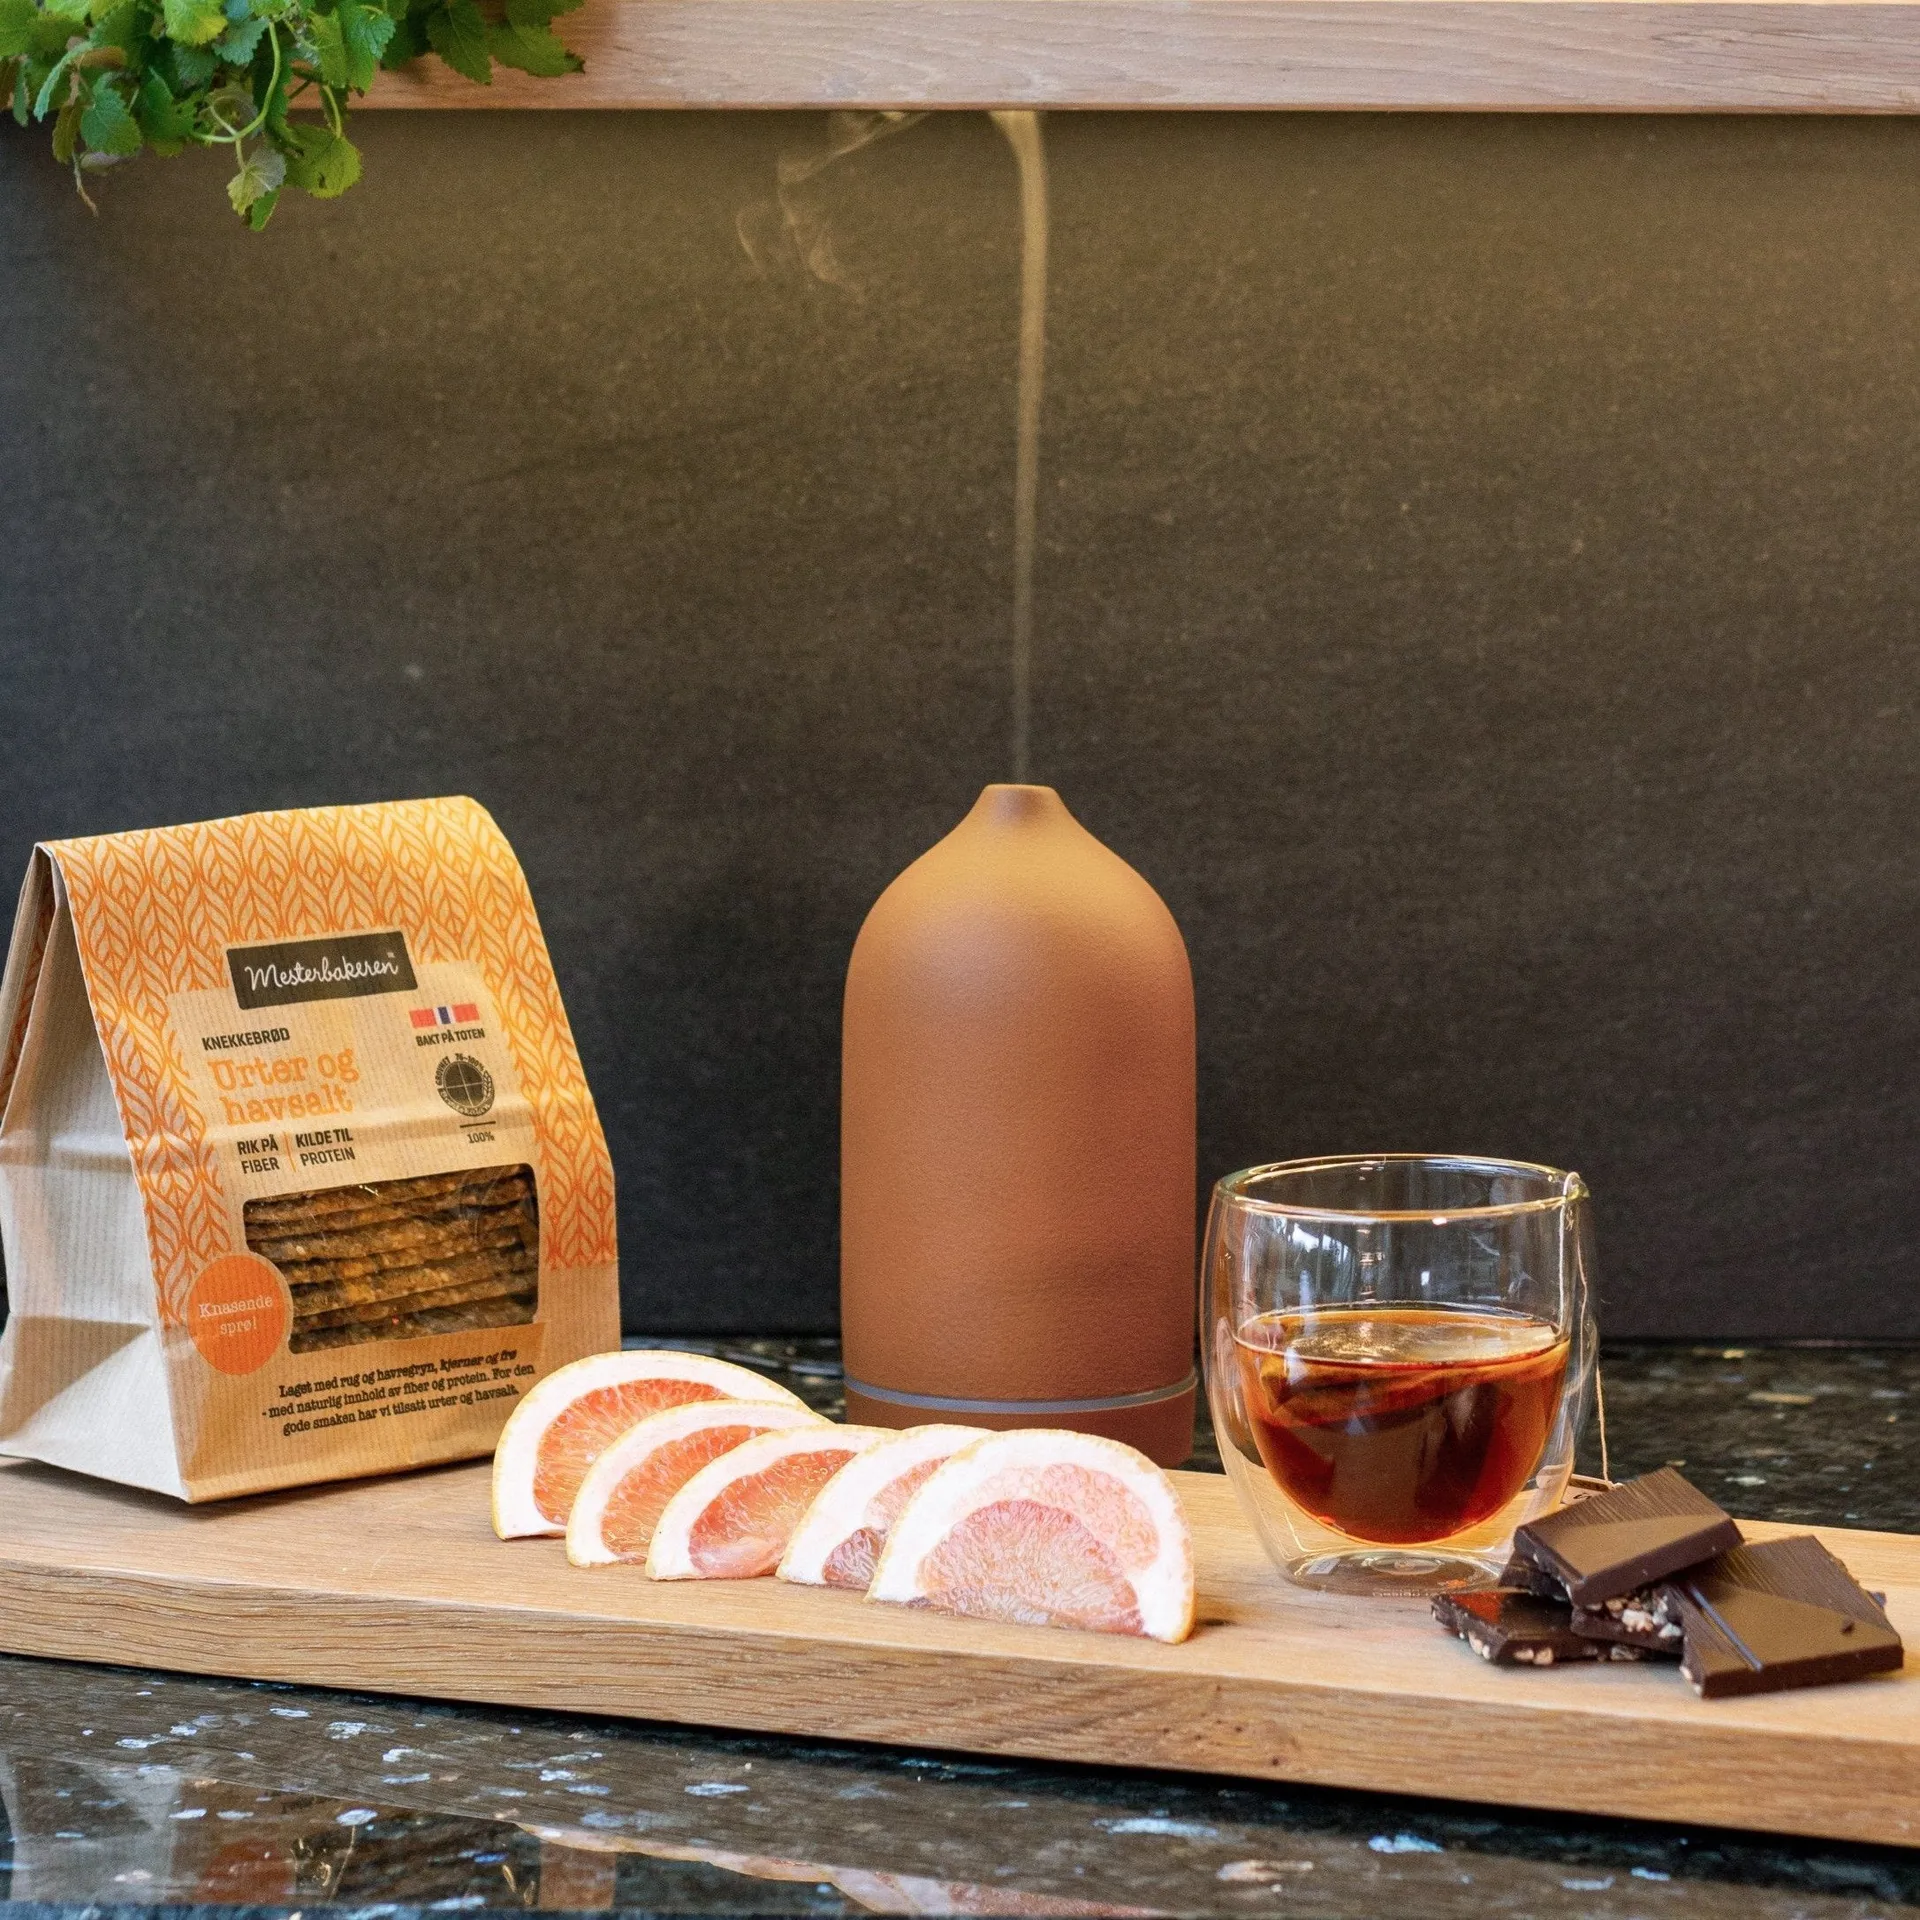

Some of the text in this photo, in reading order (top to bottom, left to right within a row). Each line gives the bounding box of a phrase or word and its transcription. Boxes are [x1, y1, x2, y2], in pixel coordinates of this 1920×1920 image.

[245, 956, 398, 991] Mesterbakeren
[202, 1027, 290, 1050] KNEKKEBRØD
[416, 1028, 485, 1046] BAKT PÅ TOTEN
[207, 1048, 359, 1091] Urter og
[219, 1083, 353, 1126] havsalt
[237, 1133, 279, 1155] RIK PÅ
[295, 1127, 353, 1148] KILDE TIL
[467, 1131, 495, 1144] 100%
[241, 1156, 280, 1174] FIBER
[299, 1147, 356, 1166] PROTEIN
[199, 1295, 273, 1318] Knasende
[220, 1315, 257, 1337] sprø!
[279, 1381, 313, 1398] Laget
[314, 1376, 339, 1392] med
[340, 1373, 361, 1387] rug
[362, 1371, 375, 1385] og
[377, 1362, 437, 1381] havregryn,
[440, 1354, 485, 1372] kjerner
[485, 1351, 500, 1365] og
[268, 1402, 295, 1418] med
[297, 1395, 343, 1413] naturlig
[344, 1386, 386, 1405] innhold
[388, 1385, 402, 1399] av
[403, 1381, 430, 1395] fiber
[432, 1378, 446, 1391] og
[447, 1371, 491, 1390] protein.
[492, 1366, 512, 1380] For
[513, 1363, 536, 1376] den
[283, 1419, 311, 1437] gode
[313, 1411, 357, 1429] smaken
[357, 1407, 378, 1422] har
[379, 1404, 392, 1417] vi
[392, 1398, 427, 1415] tilsatt
[428, 1394, 458, 1409] urter
[460, 1392, 474, 1405] og
